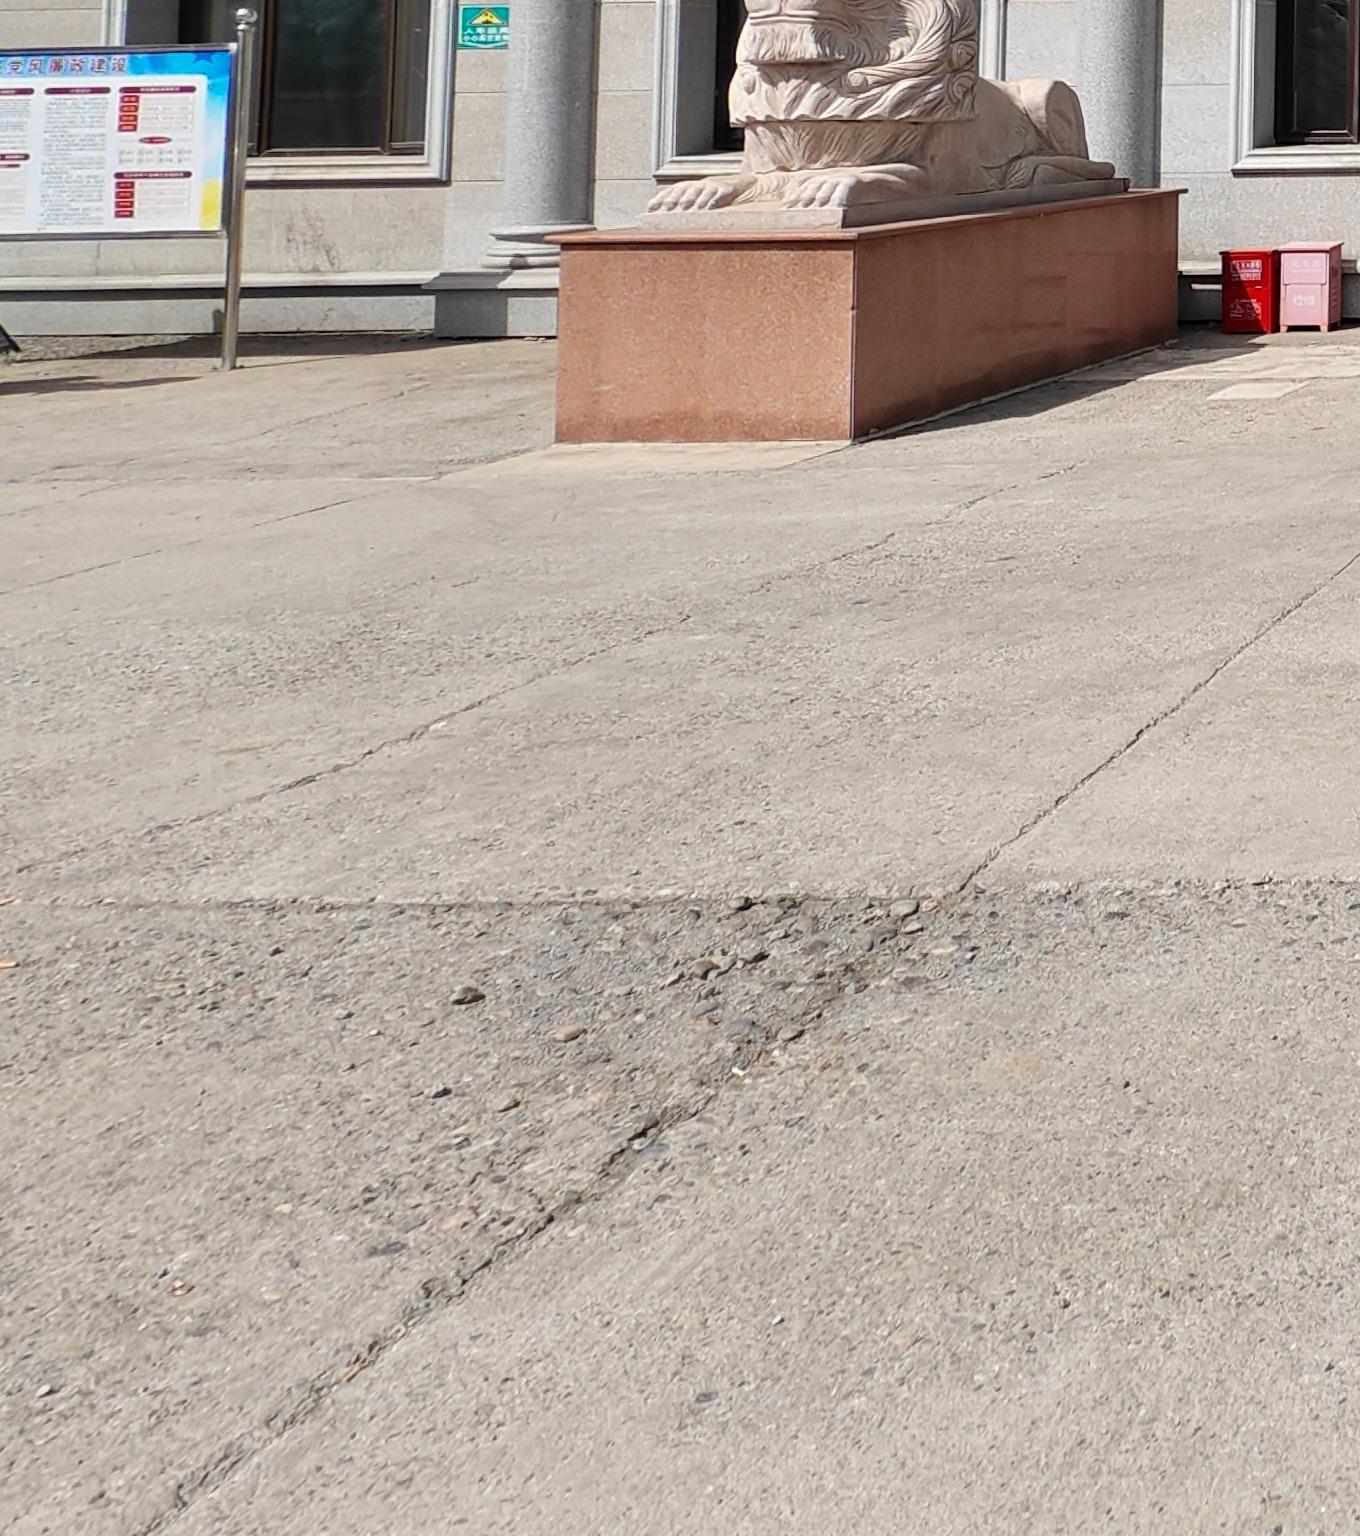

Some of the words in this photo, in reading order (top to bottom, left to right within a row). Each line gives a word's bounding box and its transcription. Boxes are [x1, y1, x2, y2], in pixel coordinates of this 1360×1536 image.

[0, 57, 127, 74] 党风廉政建设
